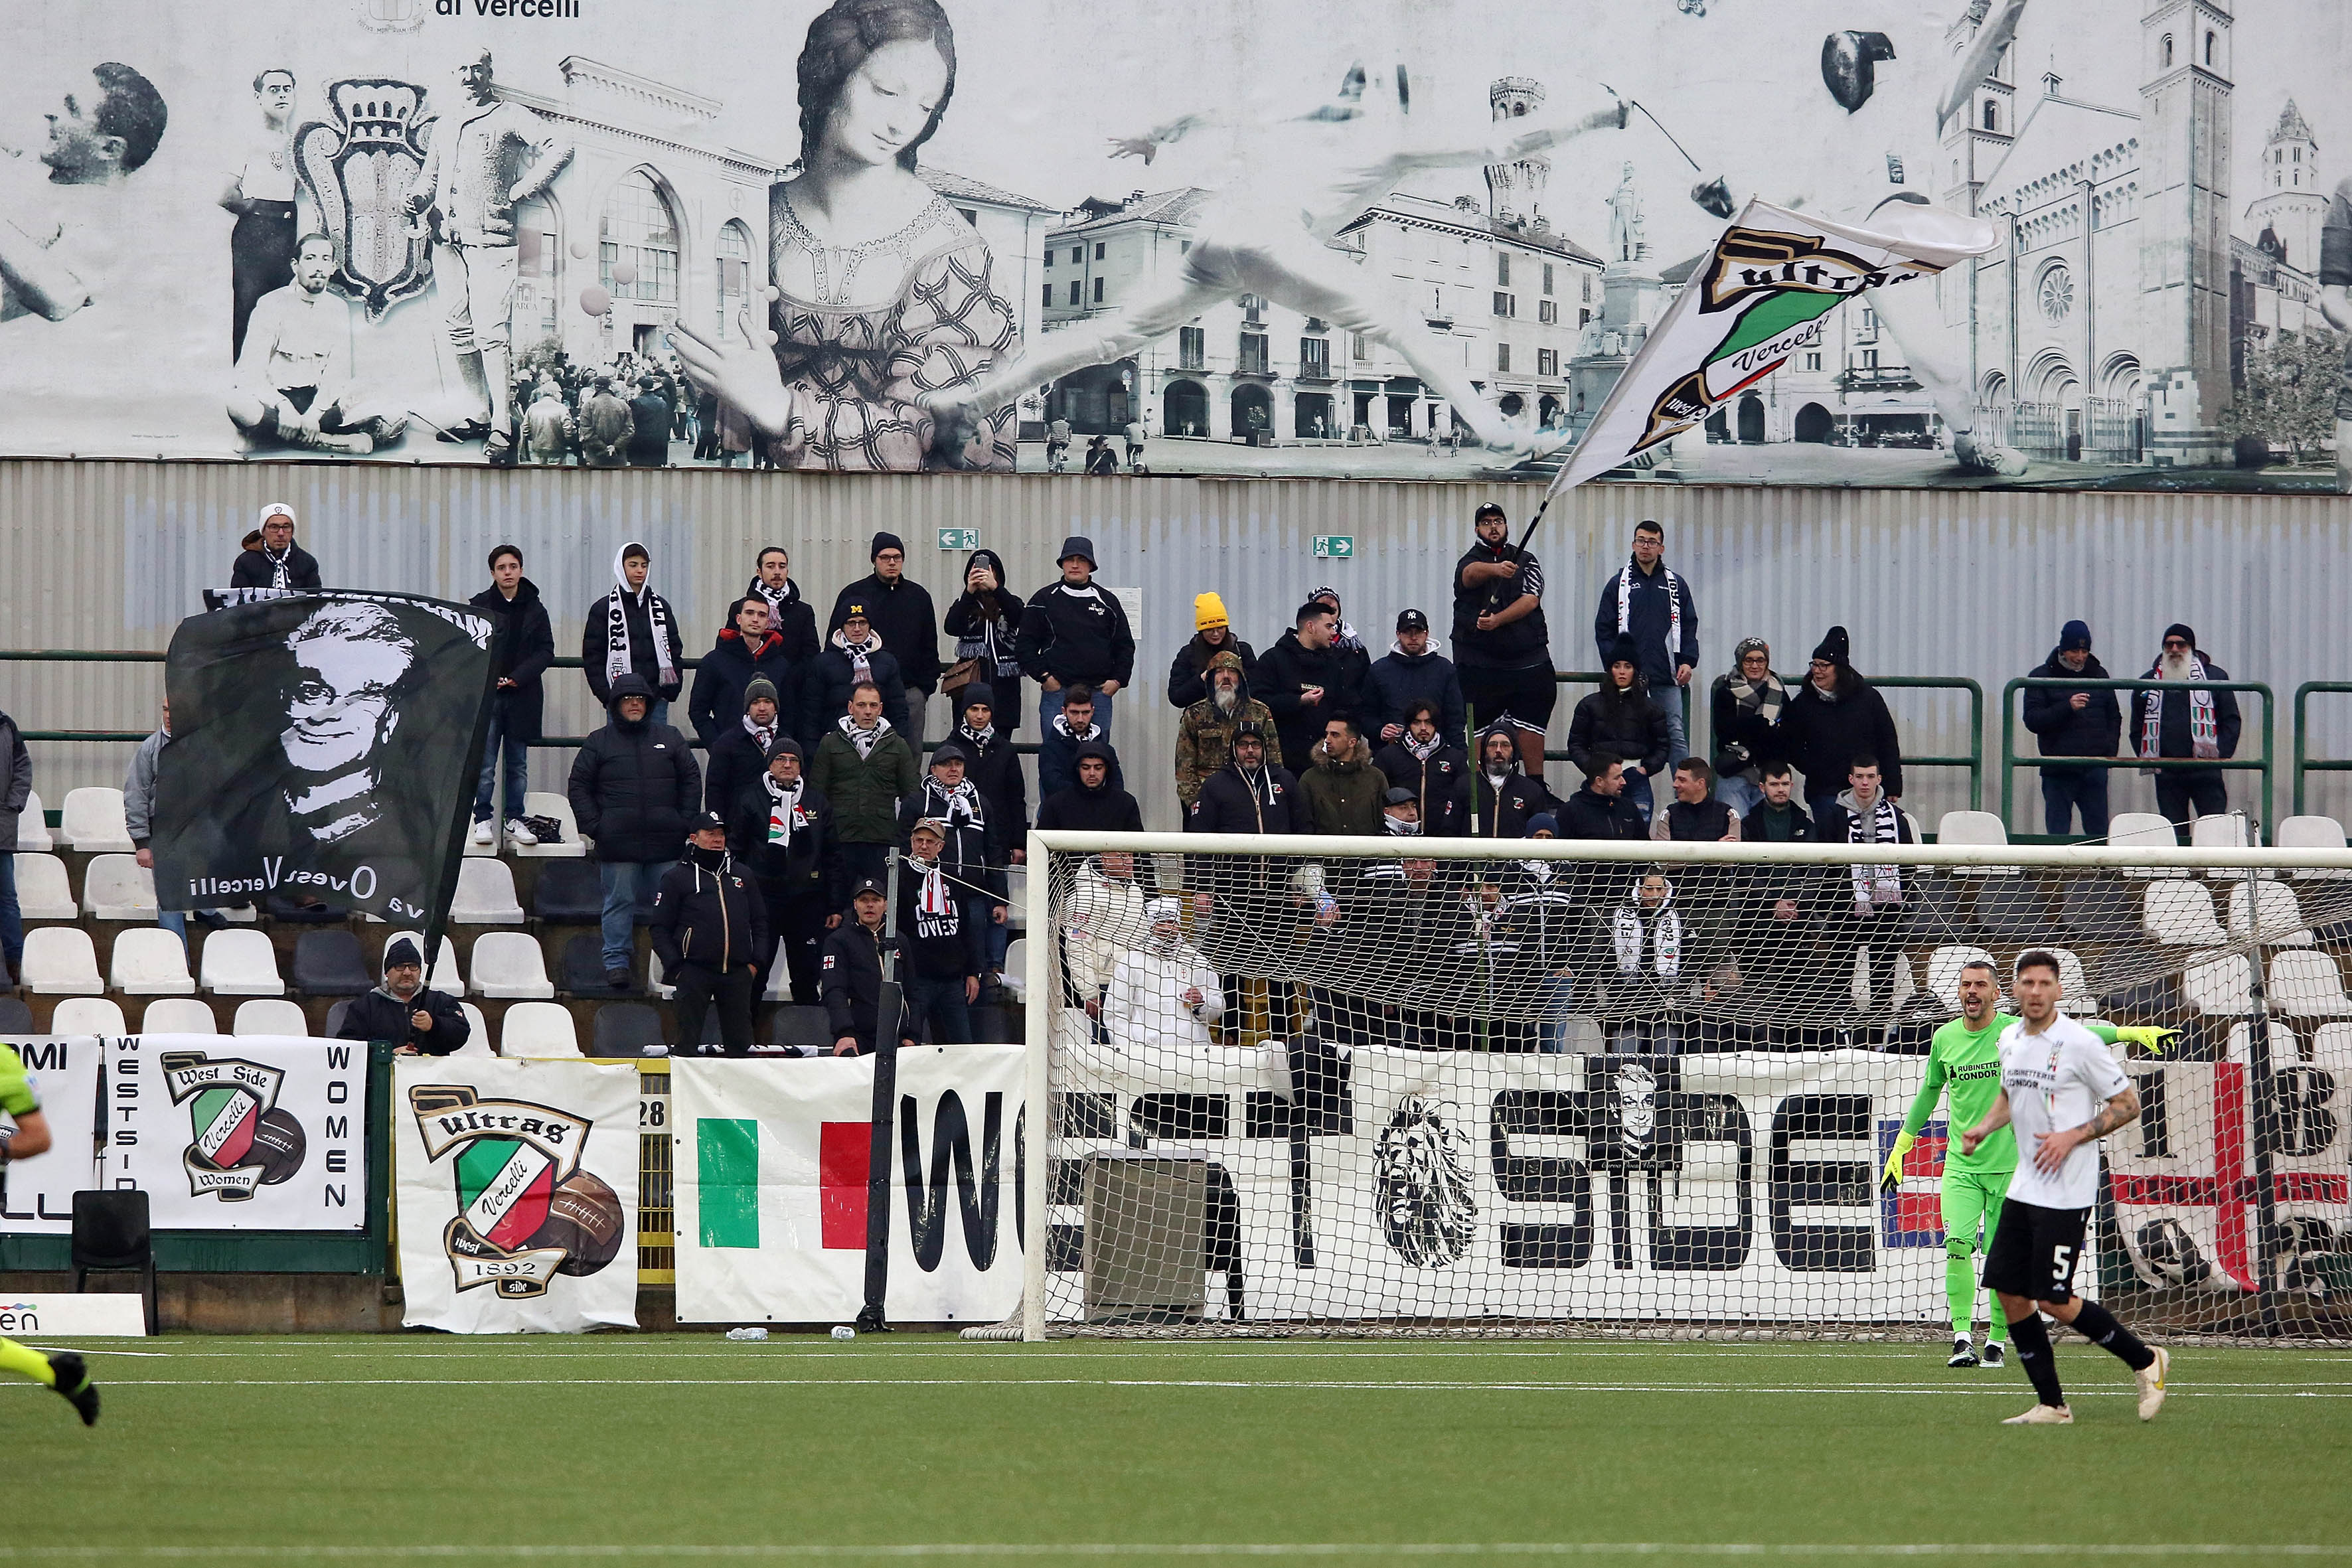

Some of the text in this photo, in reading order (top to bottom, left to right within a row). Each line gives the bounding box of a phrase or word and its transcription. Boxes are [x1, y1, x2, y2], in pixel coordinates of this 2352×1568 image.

[850, 605, 863, 613] M
[609, 608, 627, 653] PRO
[177, 1065, 268, 1088] West Side
[1959, 1069, 1998, 1081] CONDOR
[204, 1097, 246, 1150] Vercelli
[199, 1174, 250, 1186] Women
[482, 1160, 527, 1215] Vercelli
[475, 1263, 536, 1275] 1892
[2052, 1245, 2071, 1281] 5
[509, 1281, 527, 1292] side
